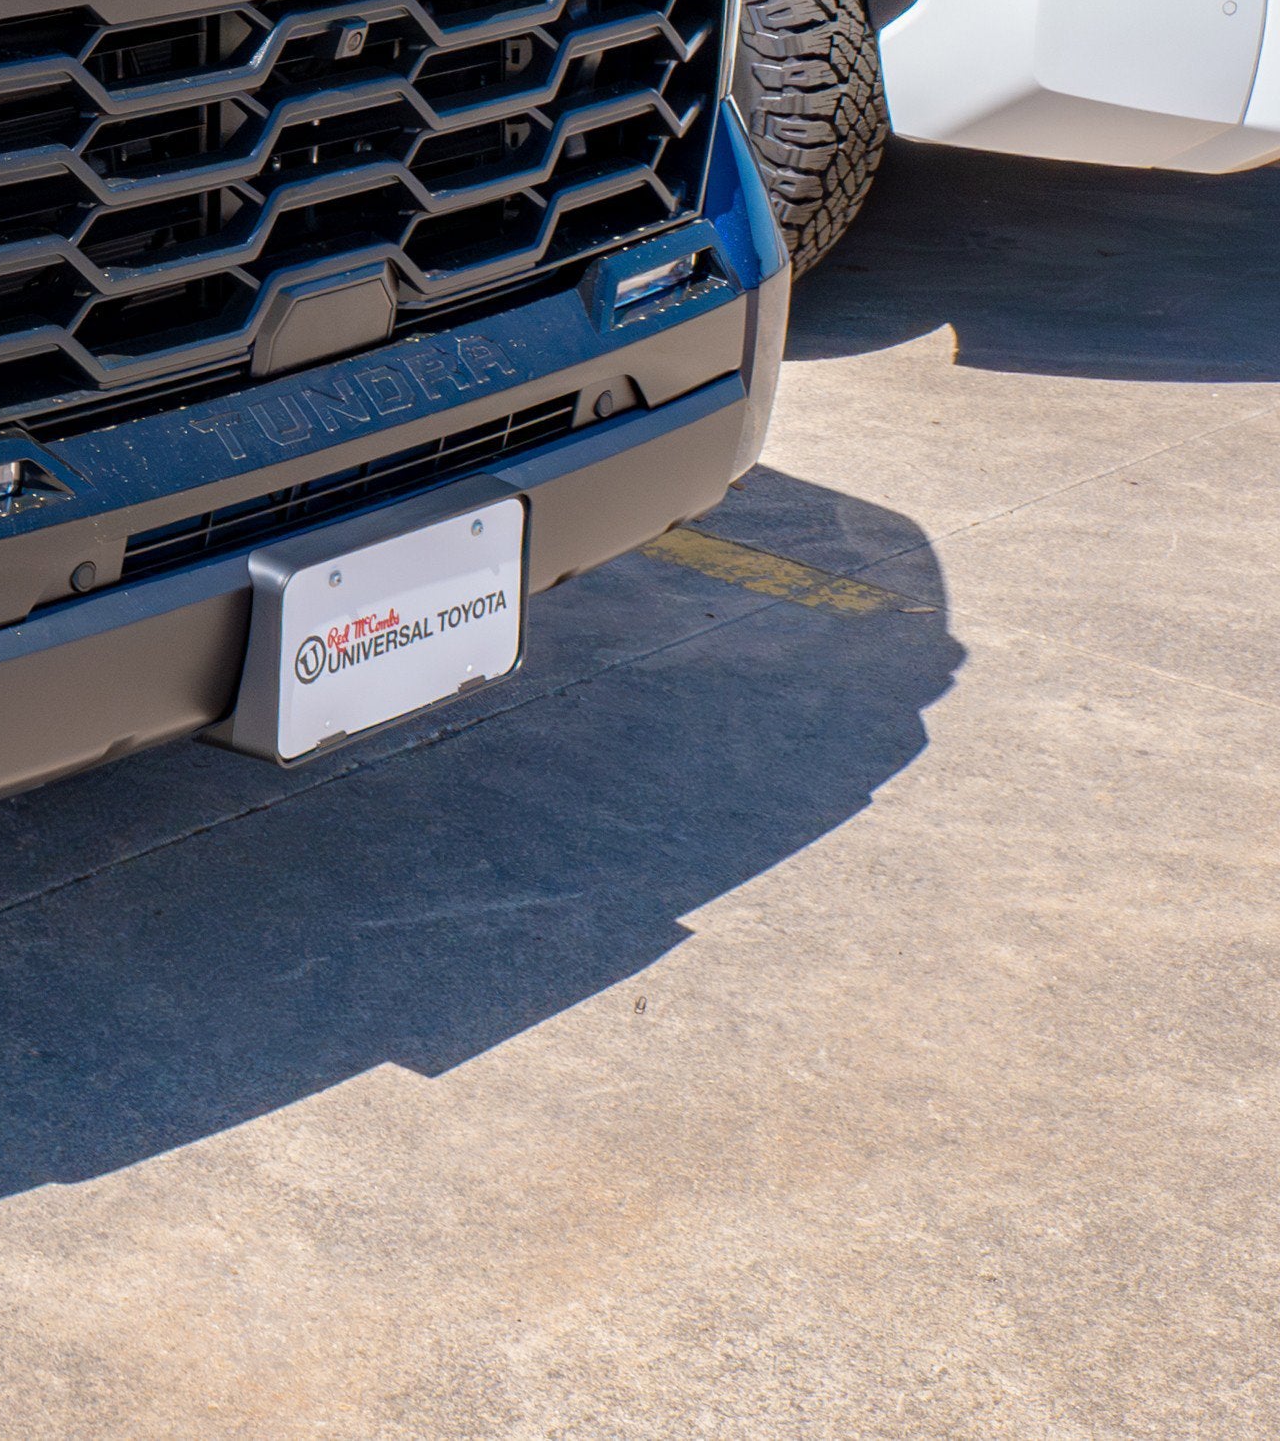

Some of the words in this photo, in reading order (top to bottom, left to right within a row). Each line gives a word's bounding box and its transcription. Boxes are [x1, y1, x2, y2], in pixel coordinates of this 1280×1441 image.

[189, 335, 516, 460] TUNDRA
[328, 617, 434, 674] UNIVERSAL
[438, 590, 507, 633] TOYOTA
